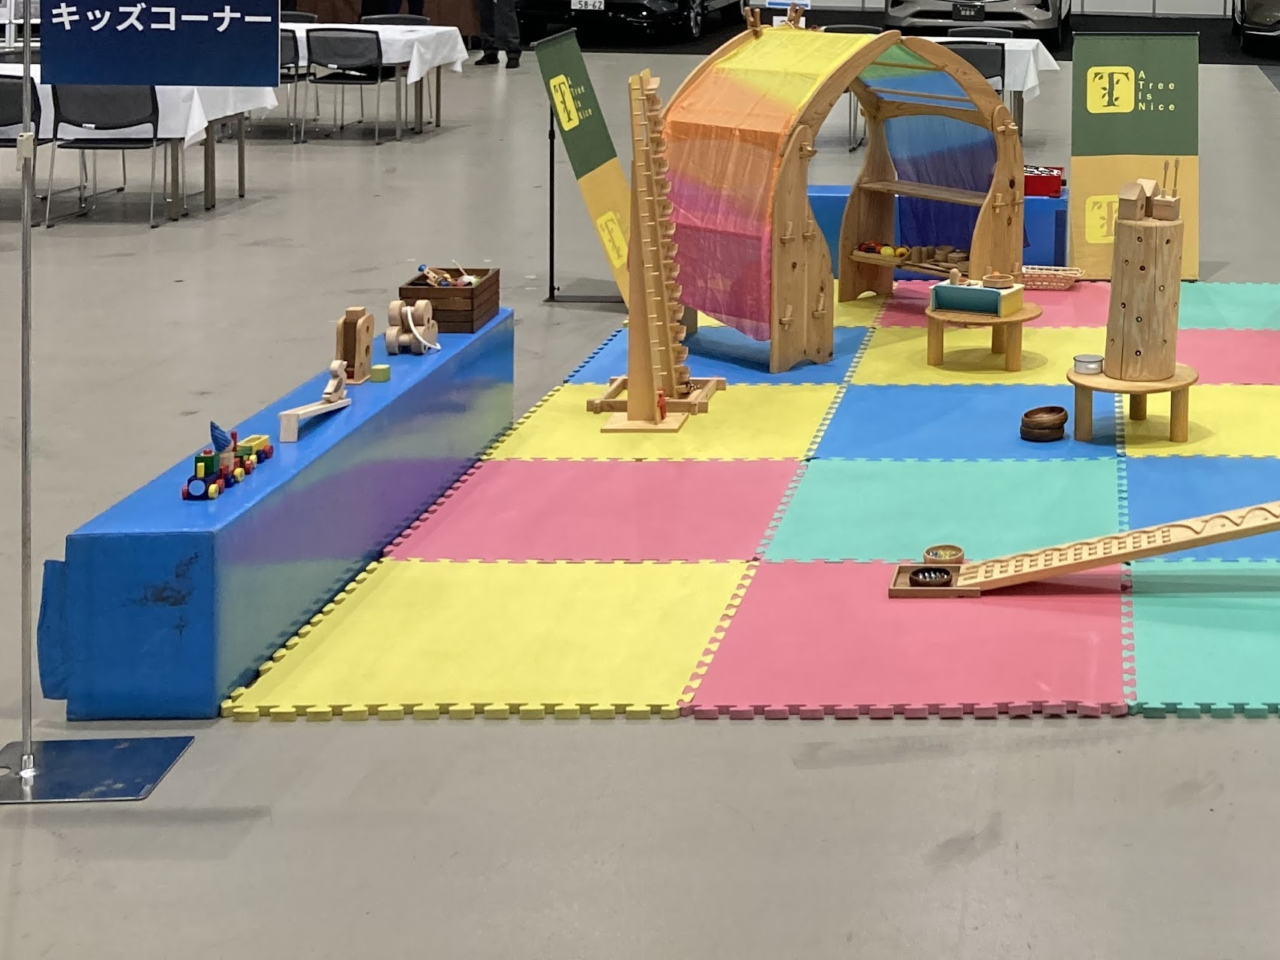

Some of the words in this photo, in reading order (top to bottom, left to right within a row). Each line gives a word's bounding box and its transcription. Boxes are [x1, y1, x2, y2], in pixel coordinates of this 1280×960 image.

[51, 2, 272, 33] キッズコーナー
[1138, 70, 1146, 79] A
[1138, 81, 1175, 90] Tree
[1138, 92, 1152, 101] Is
[1138, 102, 1175, 111] Nice
